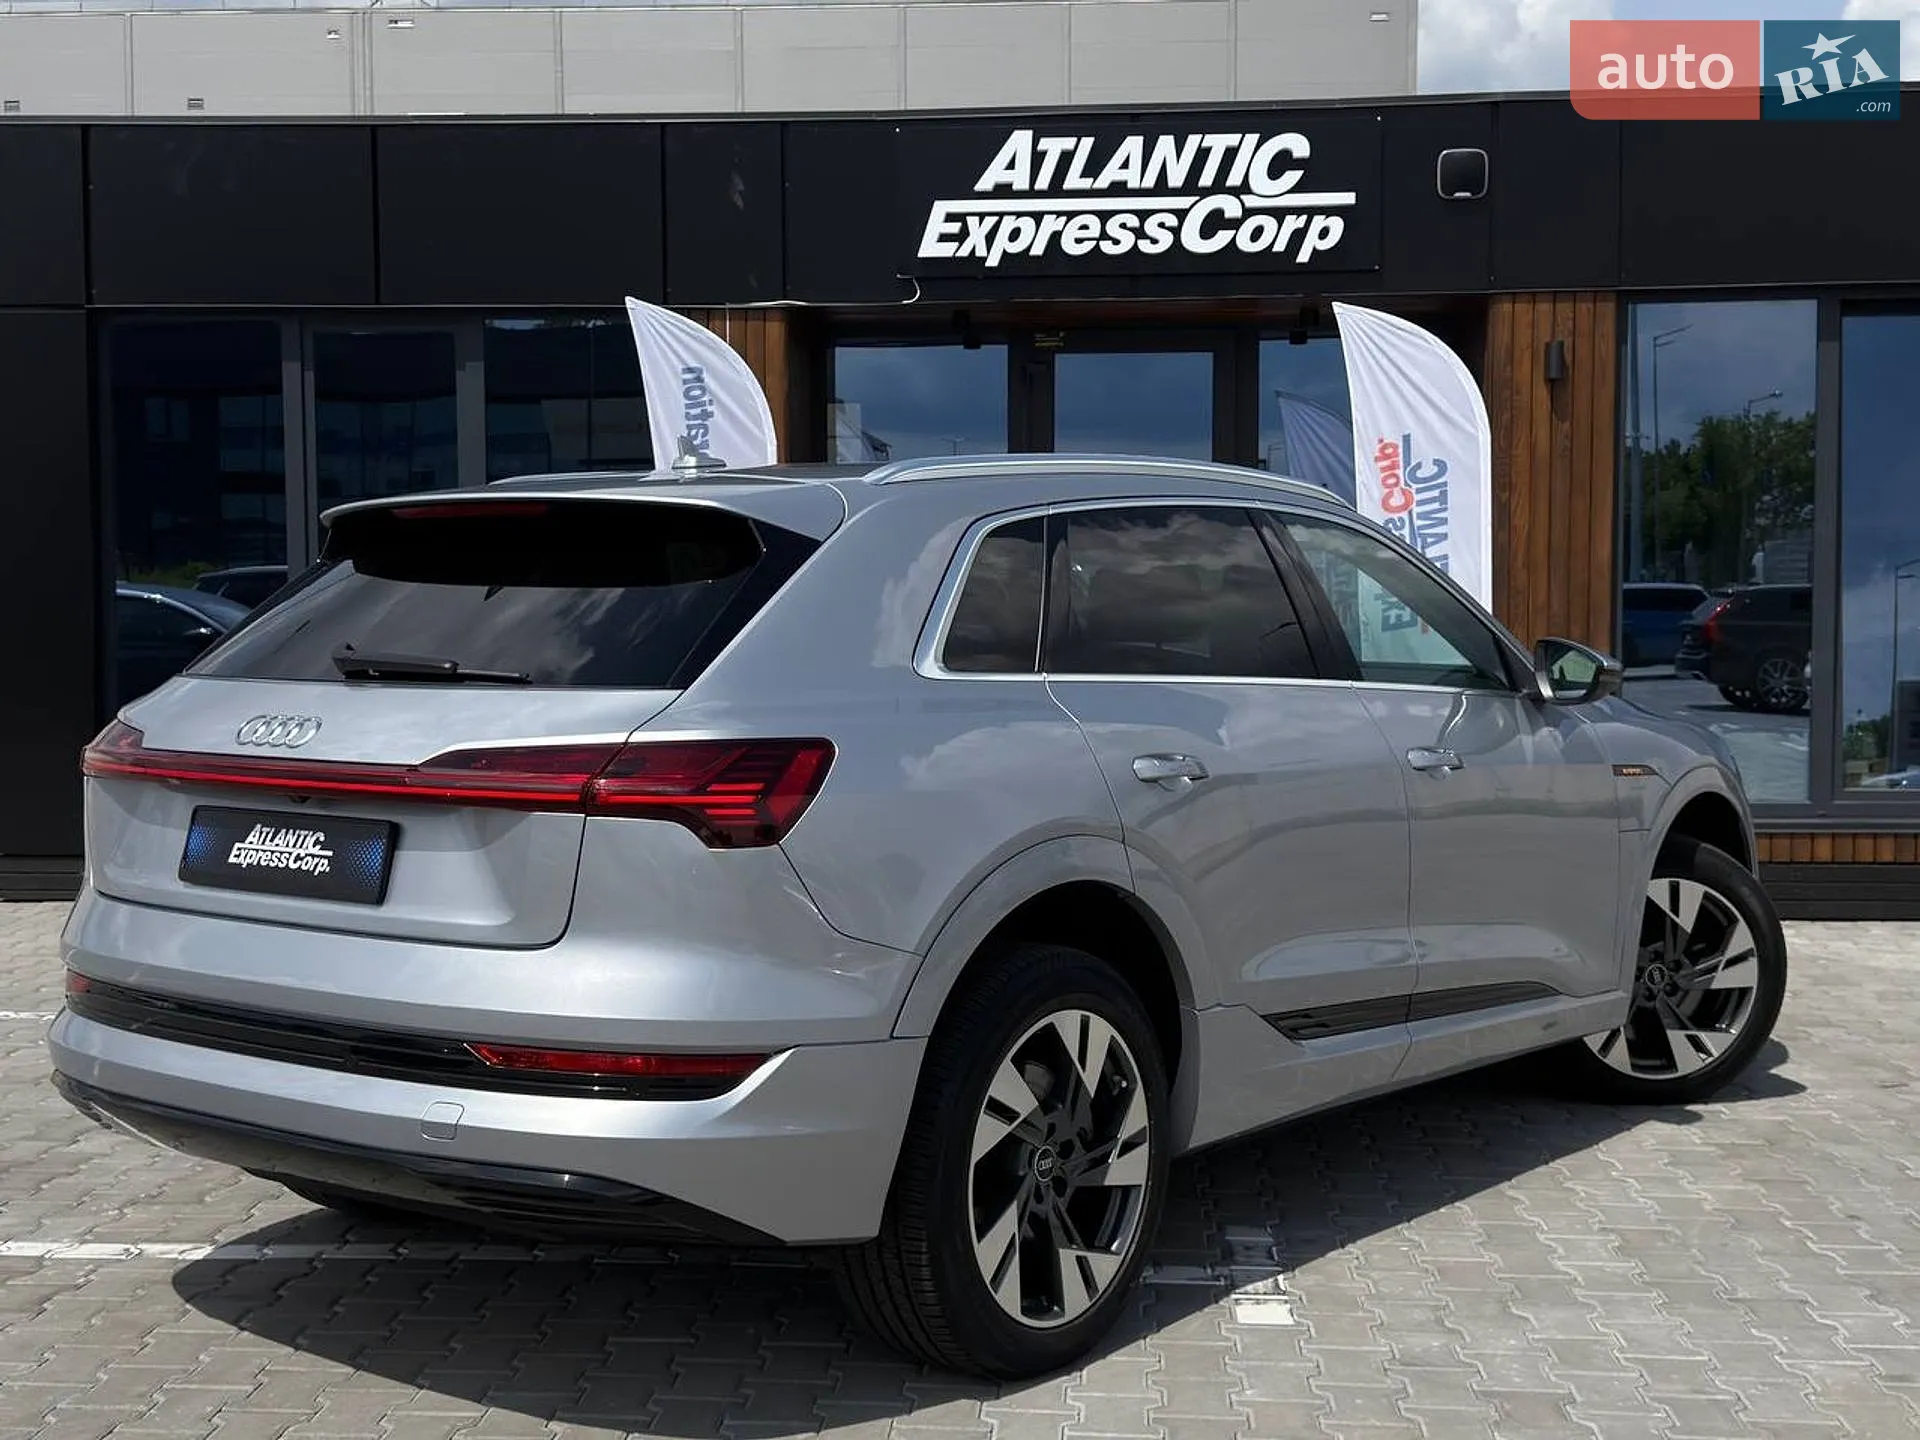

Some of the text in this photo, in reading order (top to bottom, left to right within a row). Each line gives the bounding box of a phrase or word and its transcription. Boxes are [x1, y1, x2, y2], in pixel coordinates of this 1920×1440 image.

[974, 129, 1310, 196] ATLANTIC
[918, 194, 1344, 267] ExpressCorp
[228, 842, 330, 876] ExpressCorp.
[245, 823, 326, 853] ATLANTIC
